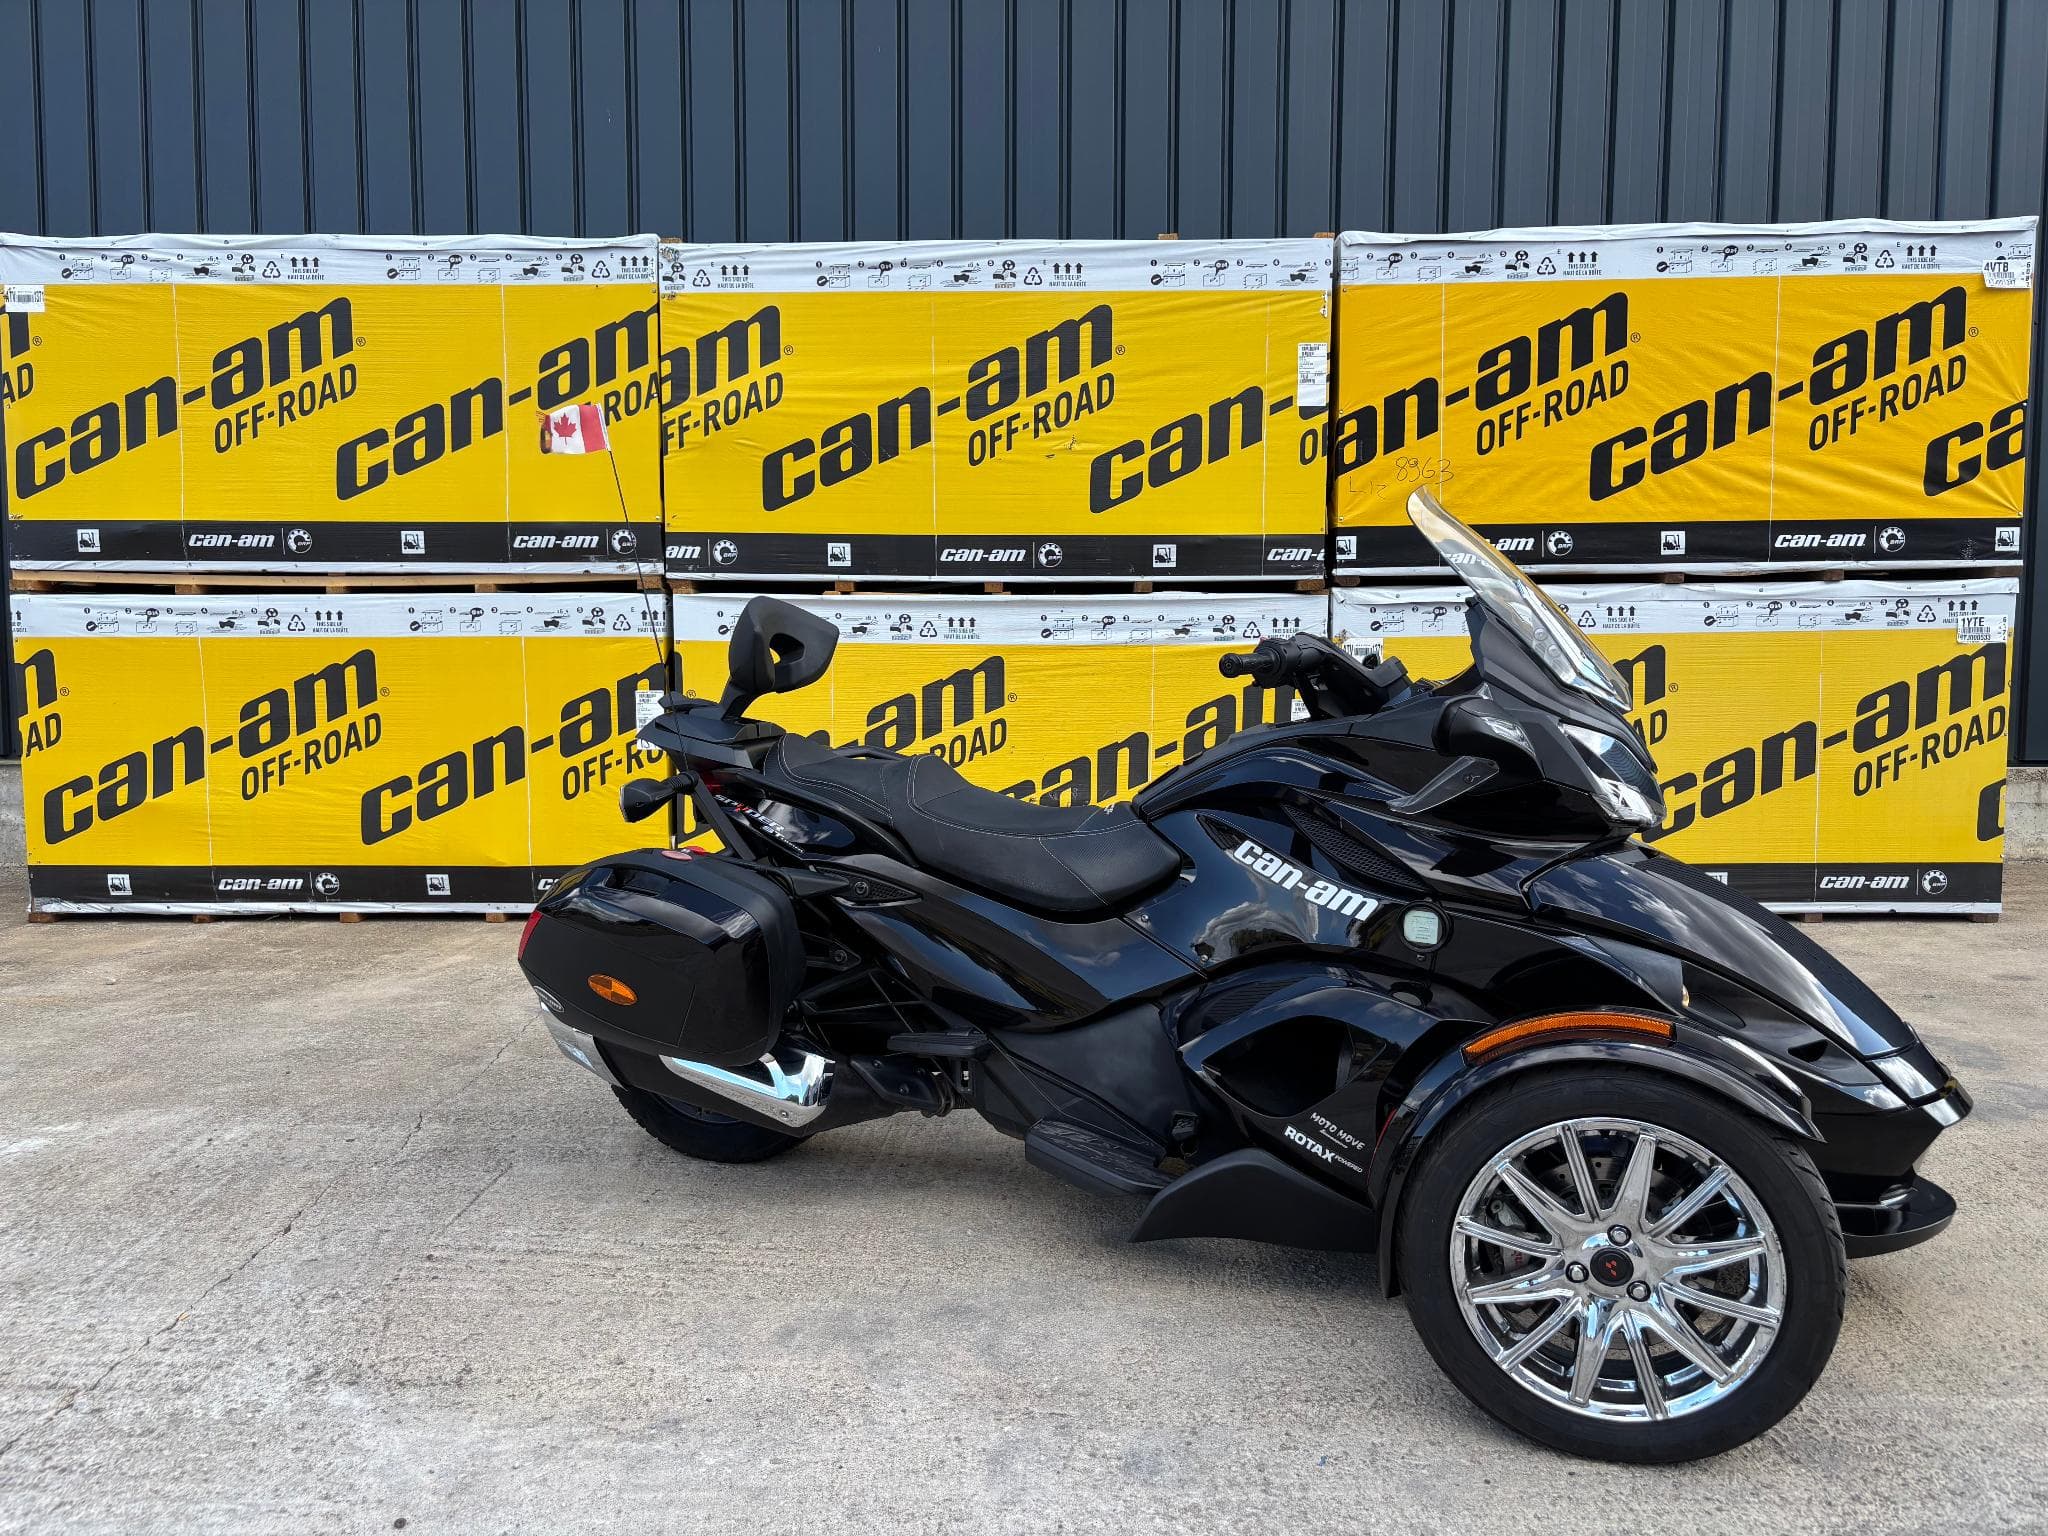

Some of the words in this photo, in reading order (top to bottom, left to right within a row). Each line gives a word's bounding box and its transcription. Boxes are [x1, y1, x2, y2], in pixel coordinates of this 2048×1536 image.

[1983, 261, 2009, 272] 4VTB
[16, 296, 354, 500] can-am
[214, 363, 357, 454] OFF-ROAD
[762, 304, 1114, 512] can-am
[968, 372, 1115, 467] OFF-ROAD
[1476, 360, 1629, 456] OFF-ROAD
[1589, 285, 1967, 502] can-am
[1808, 354, 1967, 451] OFF-ROAD
[1089, 385, 1329, 514] can-
[1395, 456, 1454, 485] 8963
[188, 534, 275, 548] can-am
[513, 535, 599, 549] can-am
[940, 548, 1027, 562] can-am
[1774, 533, 1867, 548] can-am
[1960, 617, 1985, 627] 1YTE
[43, 648, 378, 845] can-am
[241, 712, 382, 801] OFF-ROAD
[1642, 641, 2007, 844] can-am
[1852, 705, 2007, 797] OFF-ROAD
[218, 878, 304, 891] can-am
[1234, 840, 1379, 921] can-am
[1819, 876, 1909, 889] can-am
[1284, 1125, 1336, 1163] ROTAX
[1334, 1154, 1363, 1173] POWERED
[1310, 1112, 1338, 1133] MOTO
[1336, 1129, 1366, 1151] MOVE
